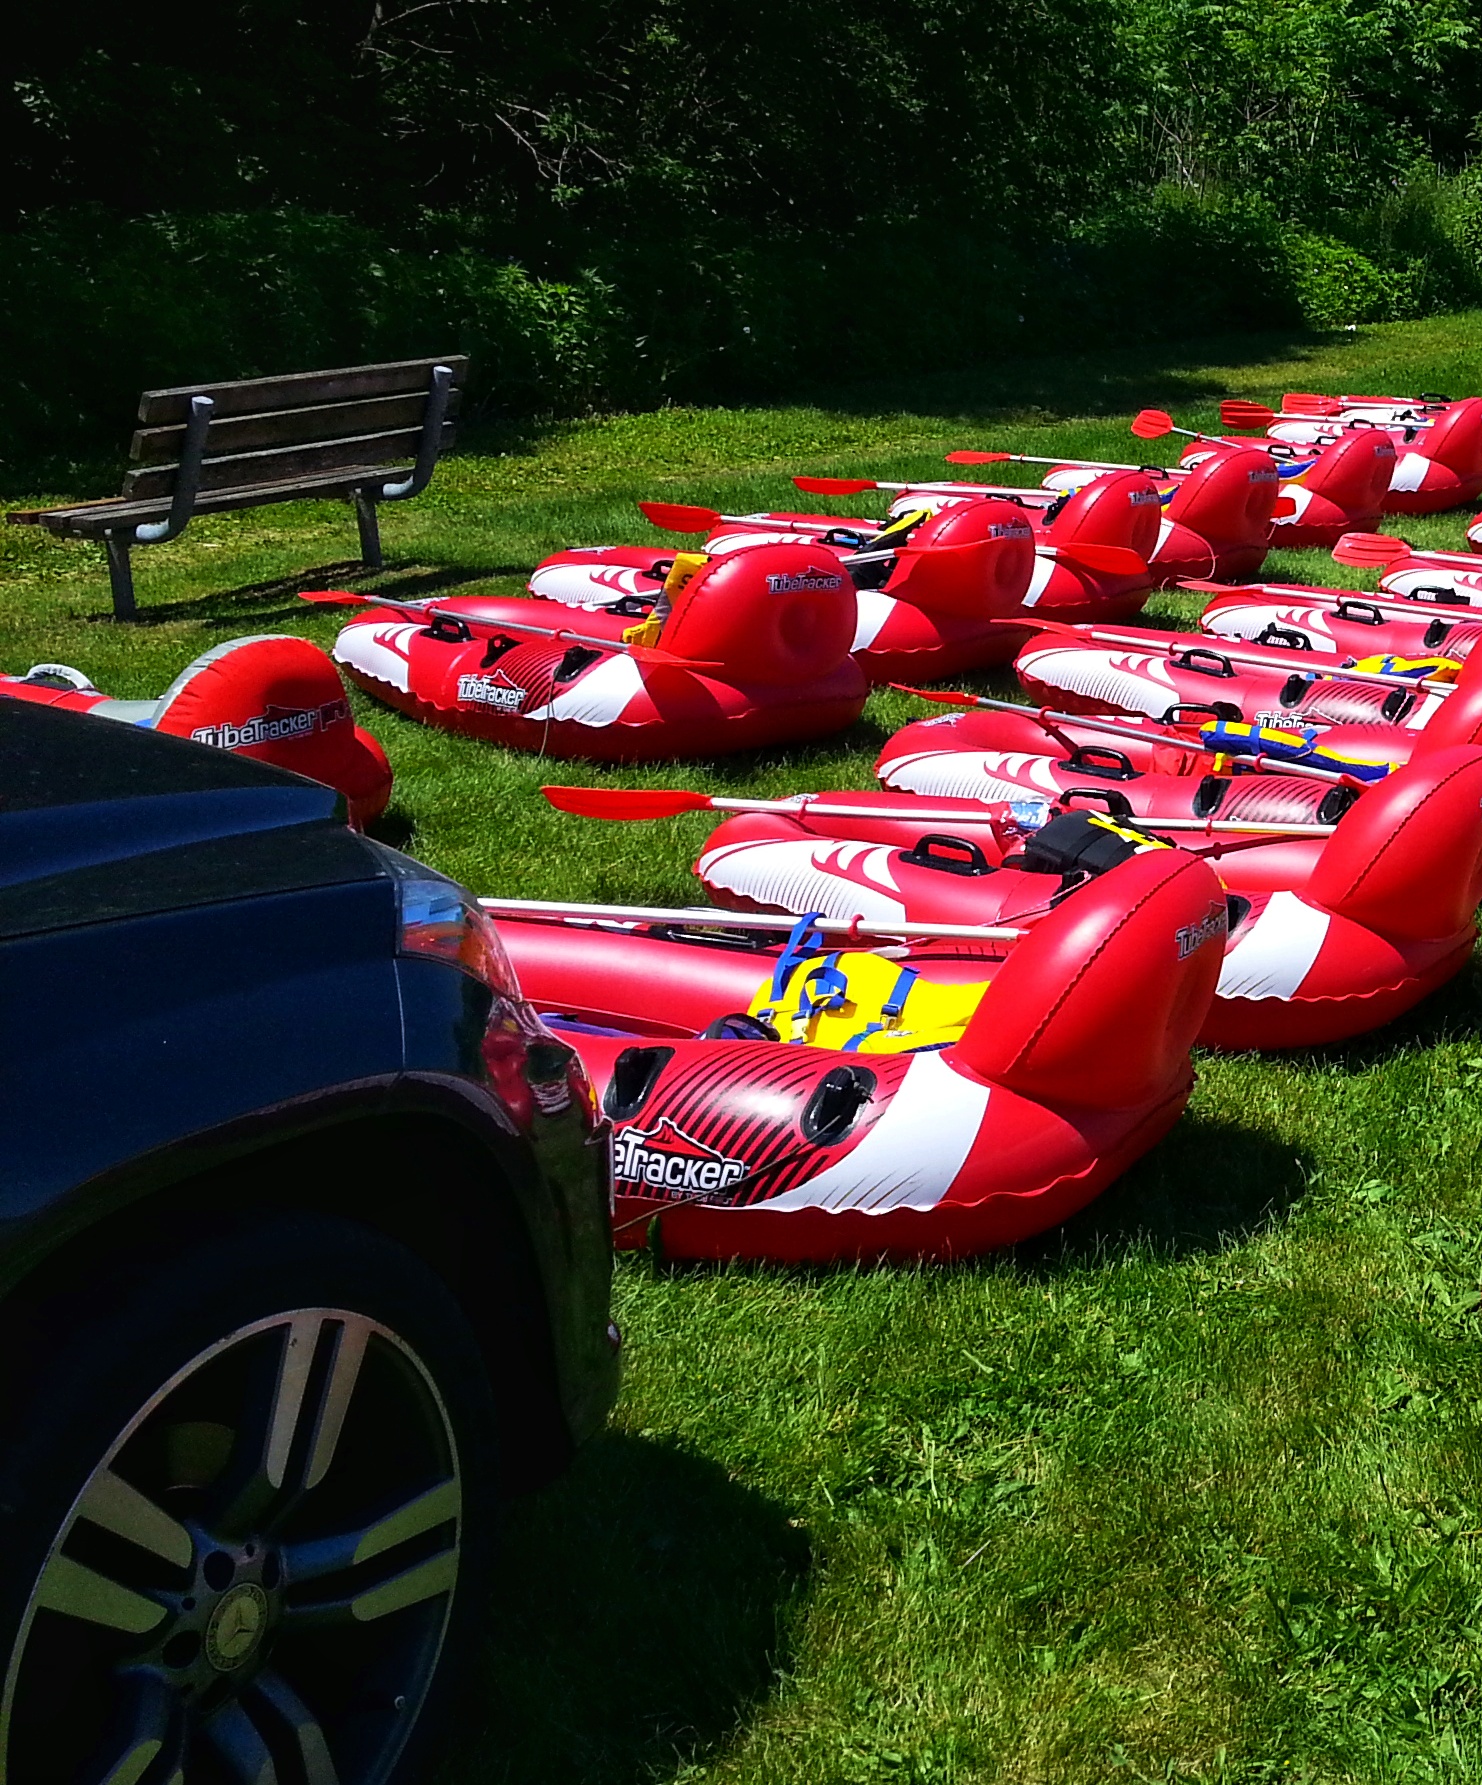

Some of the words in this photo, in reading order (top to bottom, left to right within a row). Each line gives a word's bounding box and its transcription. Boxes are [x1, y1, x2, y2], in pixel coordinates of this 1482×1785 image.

[766, 573, 842, 594] TubeTracker
[457, 674, 526, 708] TubeTracker
[190, 709, 317, 750] TubeTracker
